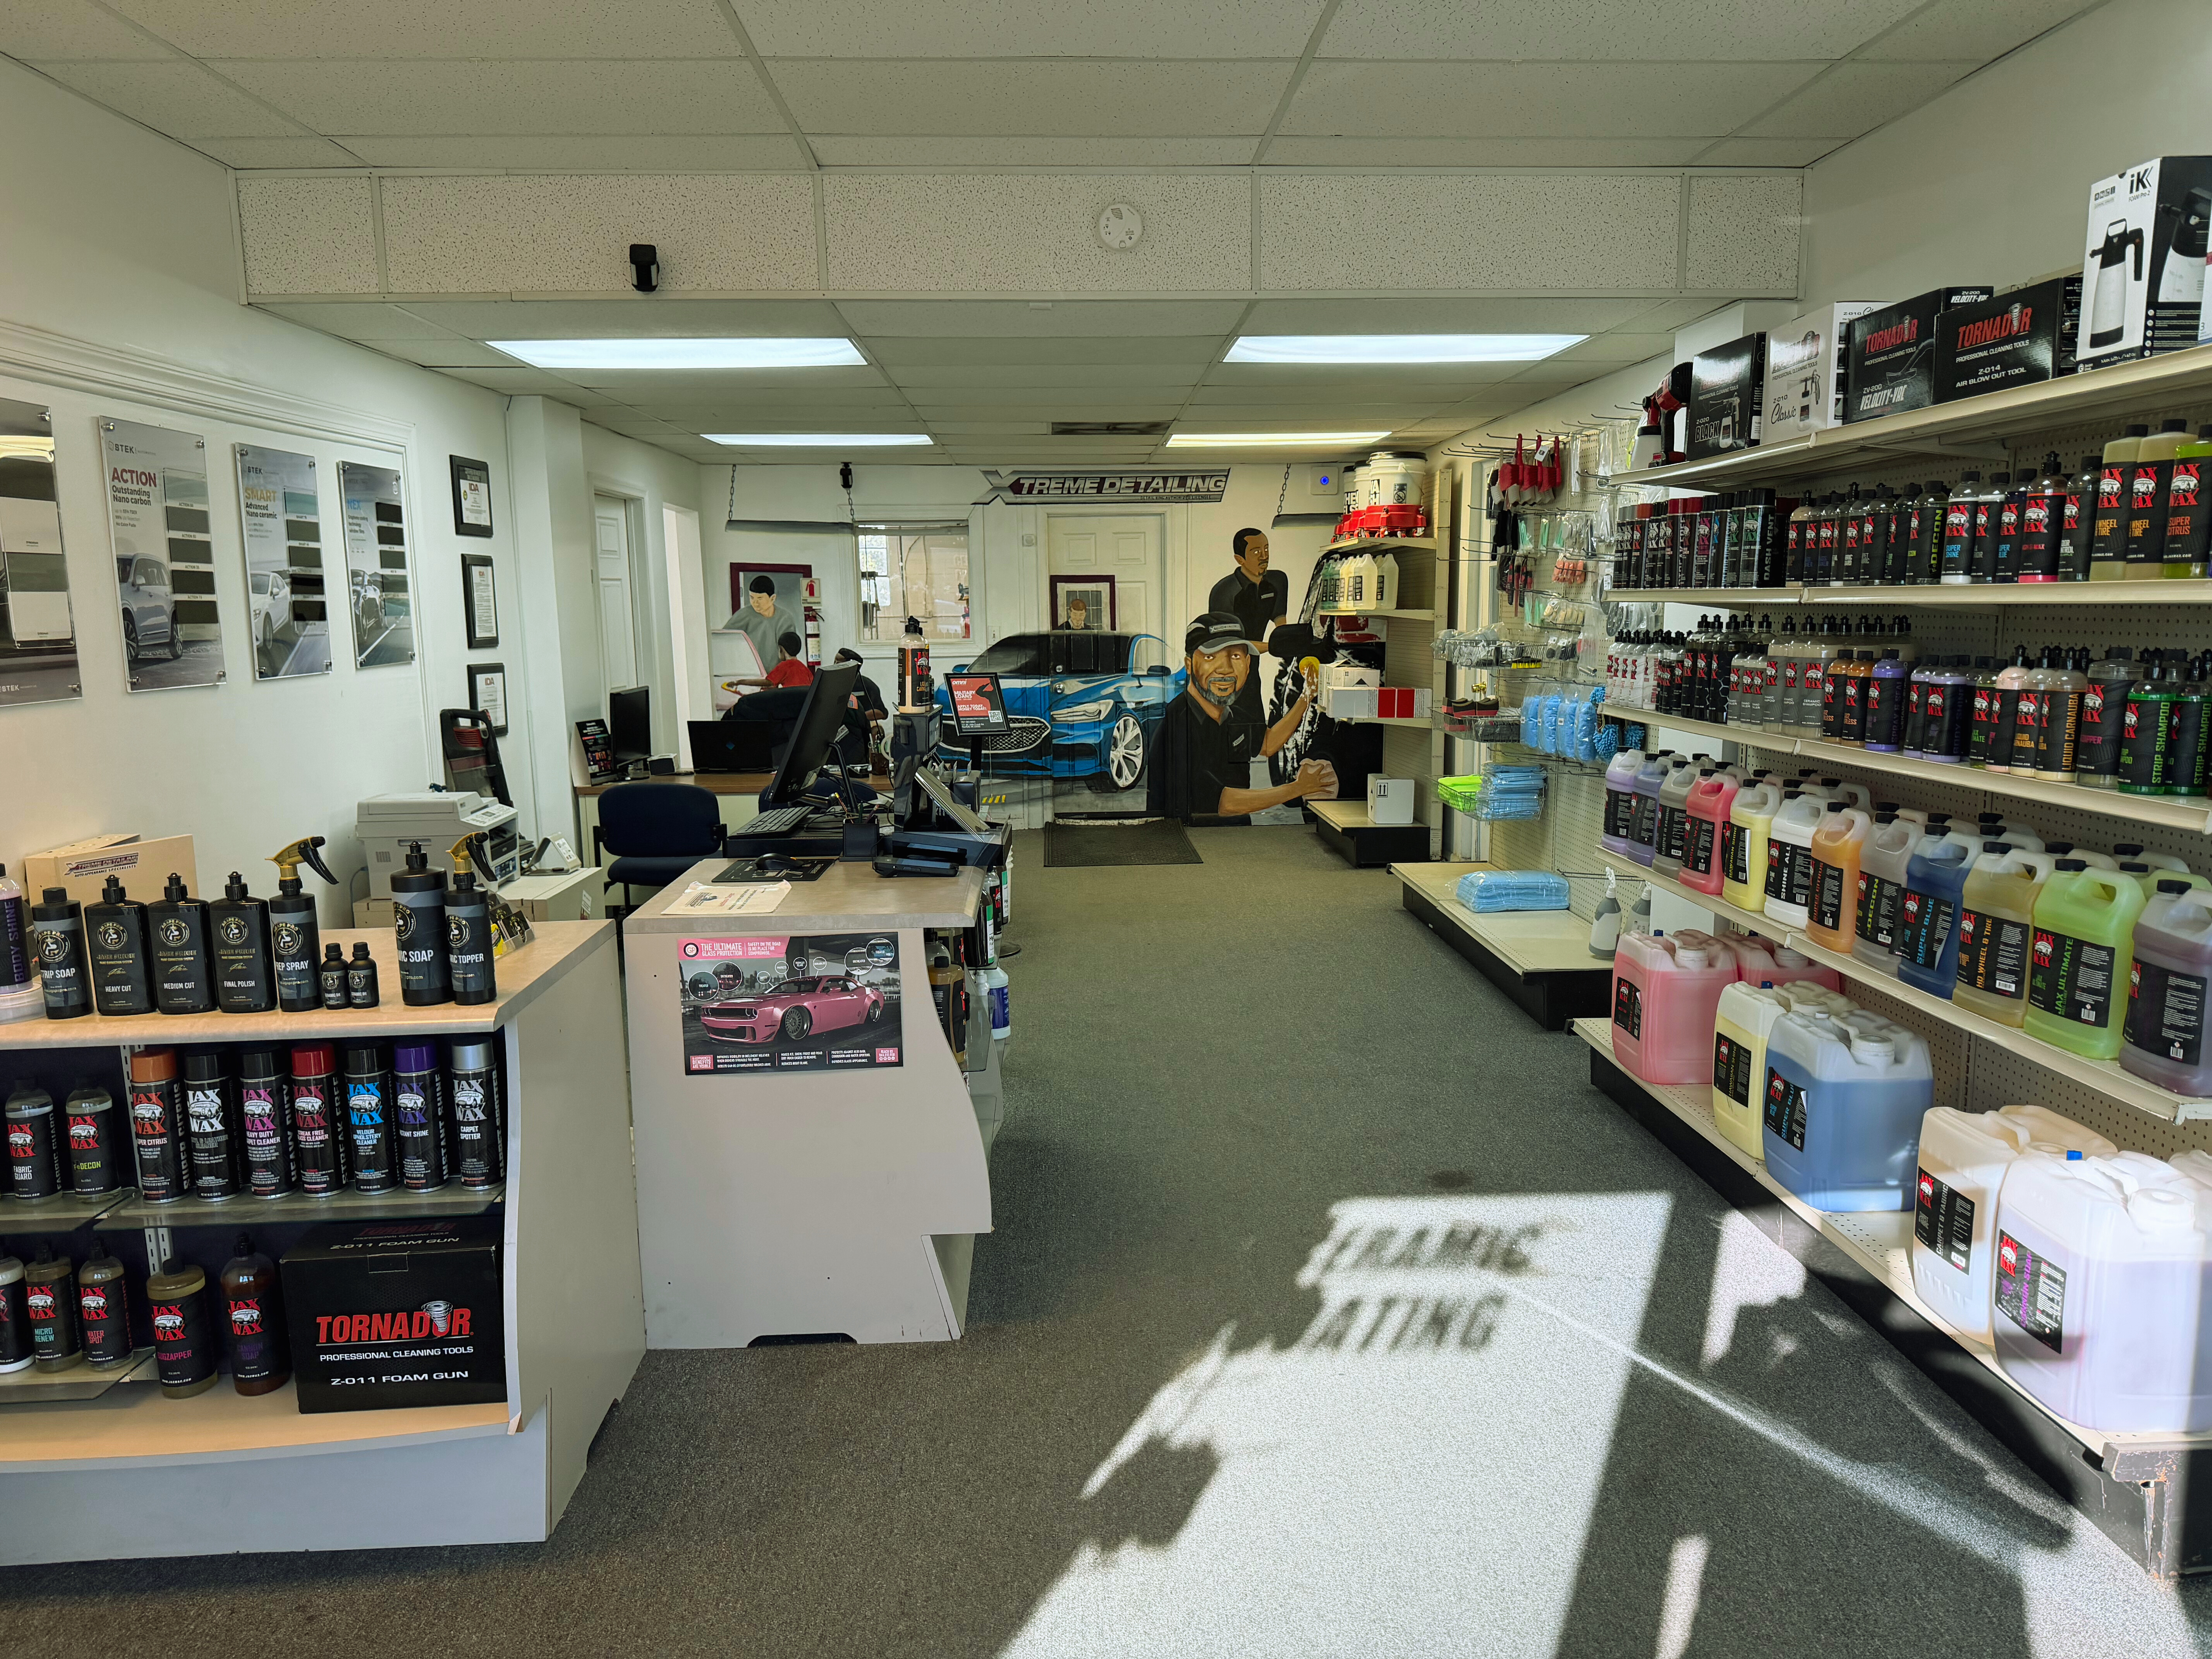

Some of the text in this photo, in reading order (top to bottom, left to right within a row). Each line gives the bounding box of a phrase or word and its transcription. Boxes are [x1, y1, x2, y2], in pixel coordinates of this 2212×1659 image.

[1956, 340, 2029, 363] PROFESSIONAL CLEANING TOOLS
[1968, 375, 1989, 385] BLOW
[1990, 371, 2005, 381] OUT
[2006, 366, 2027, 377] TOOL
[1978, 364, 2001, 374] Z-014
[1773, 395, 1788, 404] Z-010
[1771, 403, 1796, 424] Classic
[1695, 421, 1720, 443] BLACK
[112, 467, 157, 488] ACTION
[1102, 476, 1226, 494] DETAILING
[112, 485, 150, 499] Outstanding
[245, 487, 276, 502] SMART
[469, 483, 479, 493] IDA
[113, 494, 151, 506] Nano carbon
[246, 502, 268, 511] Advanced
[347, 498, 361, 510] NEX
[246, 509, 277, 519] Nano ceramic
[2169, 517, 2191, 526] SUPER
[2098, 519, 2118, 528] WHEEL
[2132, 519, 2150, 529] WHEEL
[2099, 528, 2111, 536] TIRE
[2132, 529, 2143, 537] TIRE
[1764, 514, 1775, 580] DASH VENT
[484, 677, 495, 686] IDA
[2062, 693, 2079, 771] LIQUID CARNAUBA
[2152, 702, 2170, 784] STRIP SHAMPOO
[2194, 702, 2212, 785] STRIP SHAMPOO
[1917, 898, 1934, 964] SUPER BLUE
[4, 900, 25, 982] BODY SHINE
[714, 943, 742, 951] ULTIMATE
[409, 950, 434, 962] SOAP
[459, 953, 484, 964] TOPPER
[1976, 917, 1992, 988] HD WHEEL TIRE
[55, 968, 76, 978] SOAP
[276, 960, 309, 971] REP SPRAY
[2055, 937, 2074, 1015] JAX ULTIMATE
[349, 1105, 384, 1125] WAX
[455, 1102, 488, 1121] WAX
[190, 1112, 225, 1133] WAX
[1781, 1108, 1790, 1140] SUPER
[257, 1137, 281, 1146] CLEANER
[1936, 1184, 1949, 1254] CARPET FABRIC
[152, 1304, 183, 1320] JAX
[228, 1298, 261, 1315] JAX
[155, 1324, 187, 1341] WAX
[232, 1317, 264, 1335] WAX
[316, 1308, 471, 1343] TORNADOR
[35, 1334, 54, 1342] RENEW
[242, 1352, 259, 1360] SOAP
[320, 1346, 474, 1362] PROFESSIONAL CLEANING TOOLS
[331, 1371, 469, 1385] Z-011 FOAM GUN
